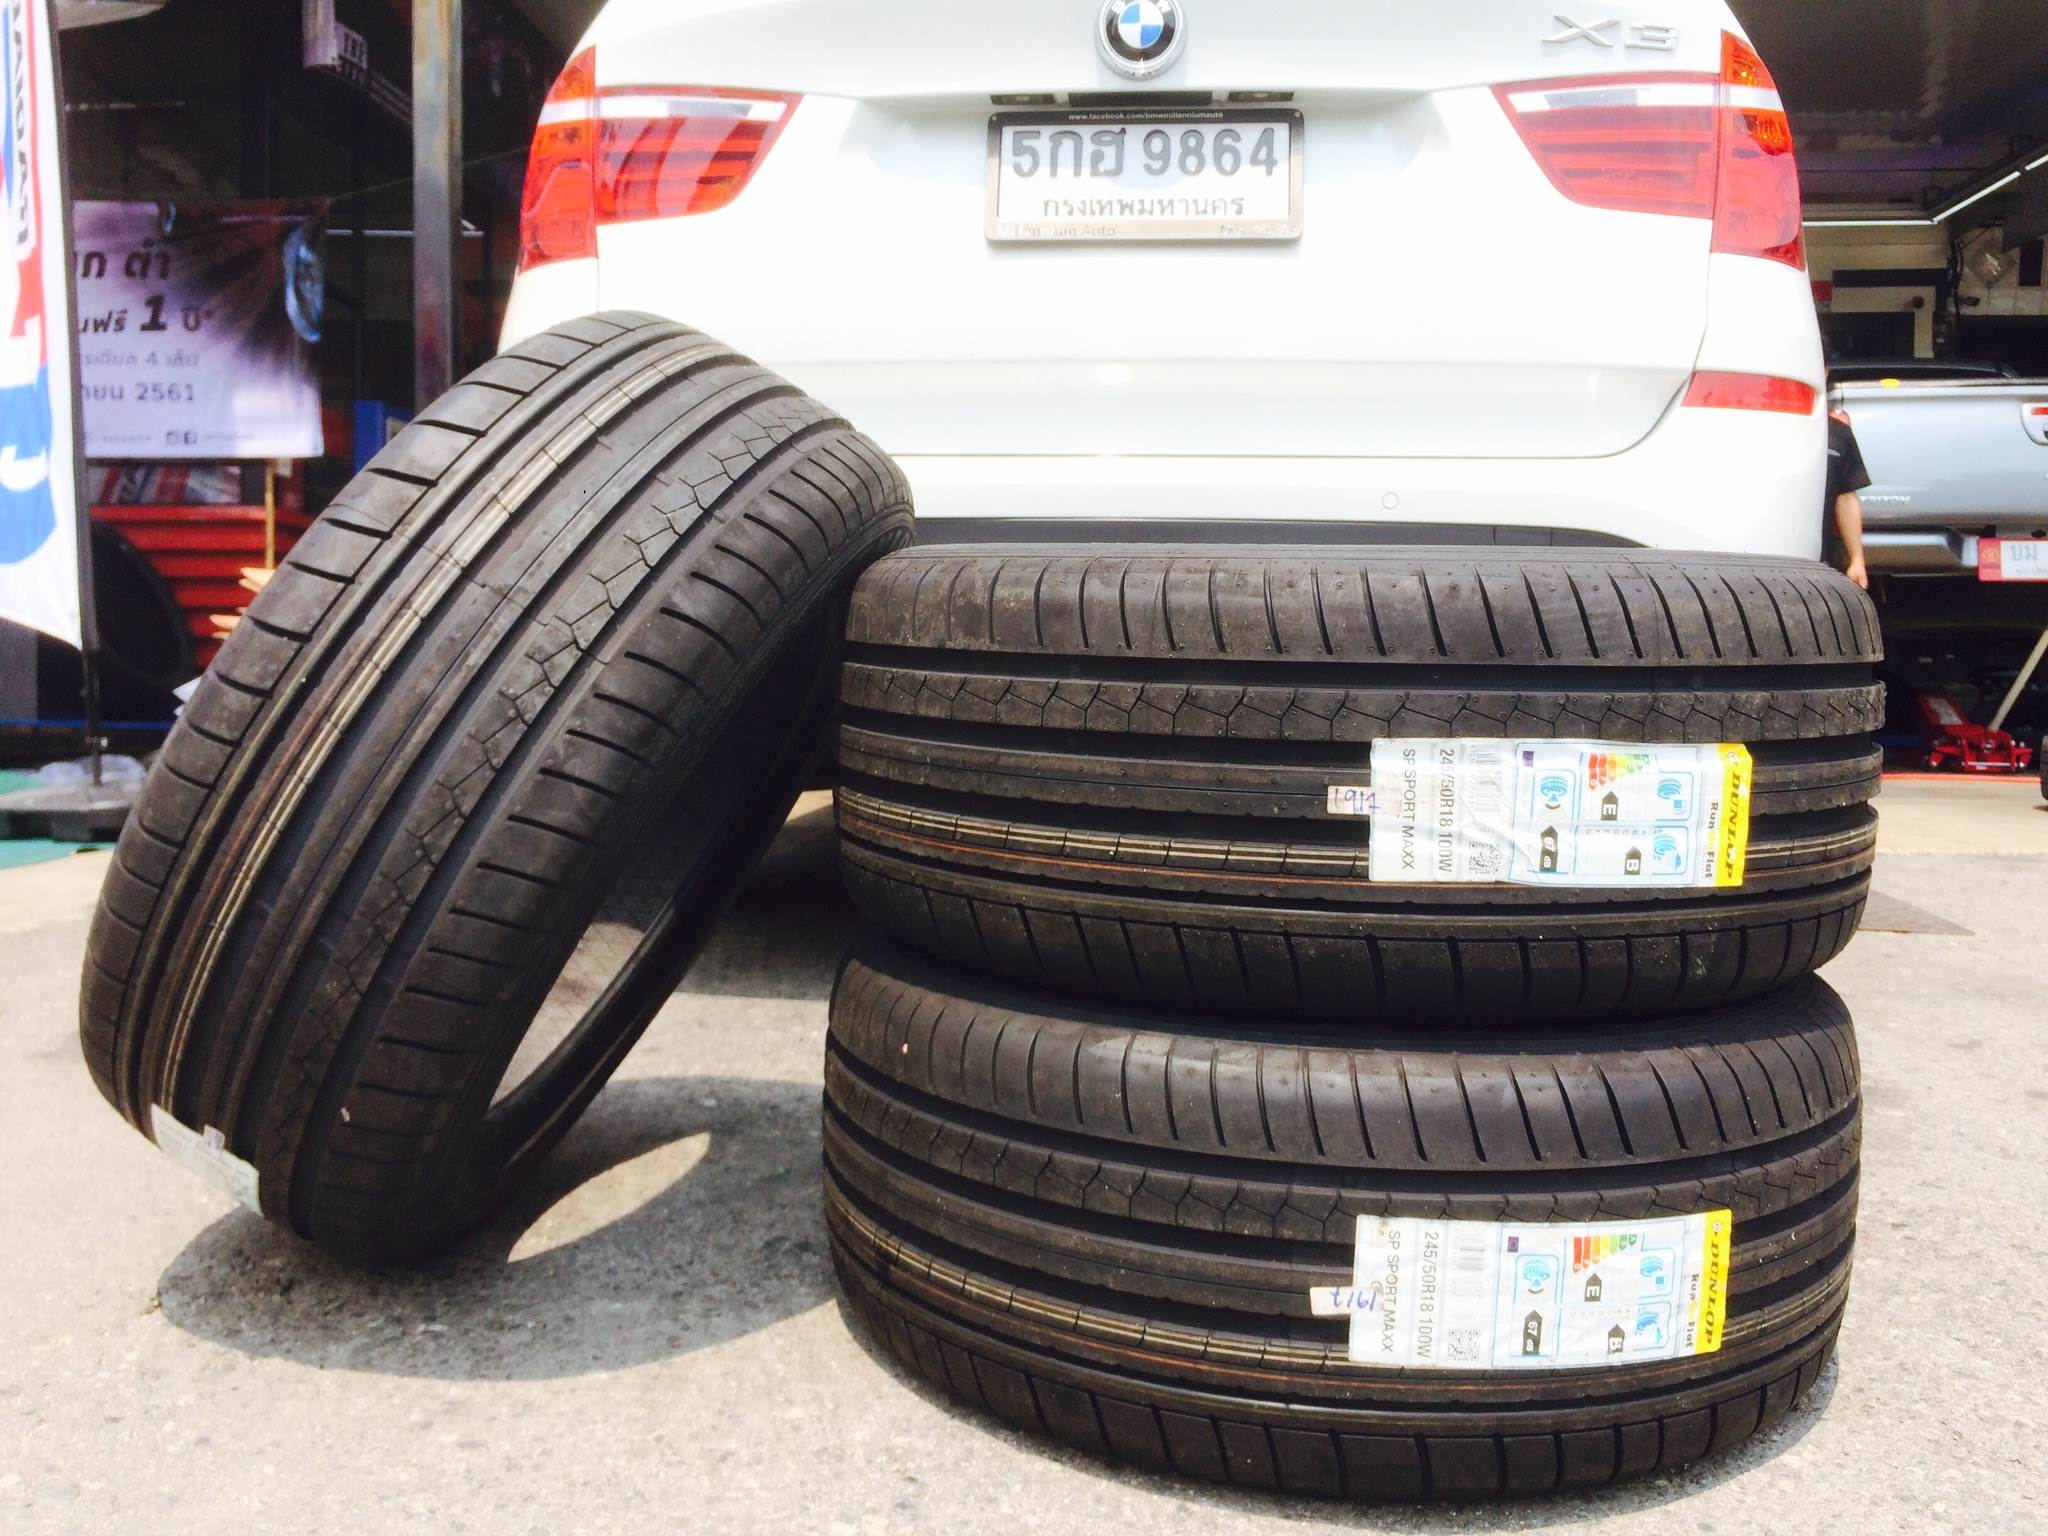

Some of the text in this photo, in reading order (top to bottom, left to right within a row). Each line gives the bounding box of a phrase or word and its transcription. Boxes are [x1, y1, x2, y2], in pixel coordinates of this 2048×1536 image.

[1111, 0, 1172, 14] BW
[1541, 15, 1680, 51] X3
[1011, 126, 1279, 179] 5กฮ 9864
[1043, 196, 1246, 219] กรงเทพมหานคร
[1082, 225, 1116, 238] Auto
[140, 292, 168, 332] 1
[136, 382, 194, 401] 2561
[1400, 747, 1417, 871] SP SPORT MAXX
[1603, 803, 1616, 816] E
[1724, 769, 1743, 880] DUNLOP
[1437, 831, 1453, 873] 100W
[1703, 801, 1720, 881] Run Flat
[1627, 858, 1639, 872] B
[1380, 1229, 1402, 1353] SP SPORT MAXX
[1416, 1231, 1440, 1358] 245/50R18 100W
[1586, 1285, 1600, 1298] E
[1704, 1239, 1720, 1346] DUNLOP
[1526, 1321, 1539, 1337] 67
